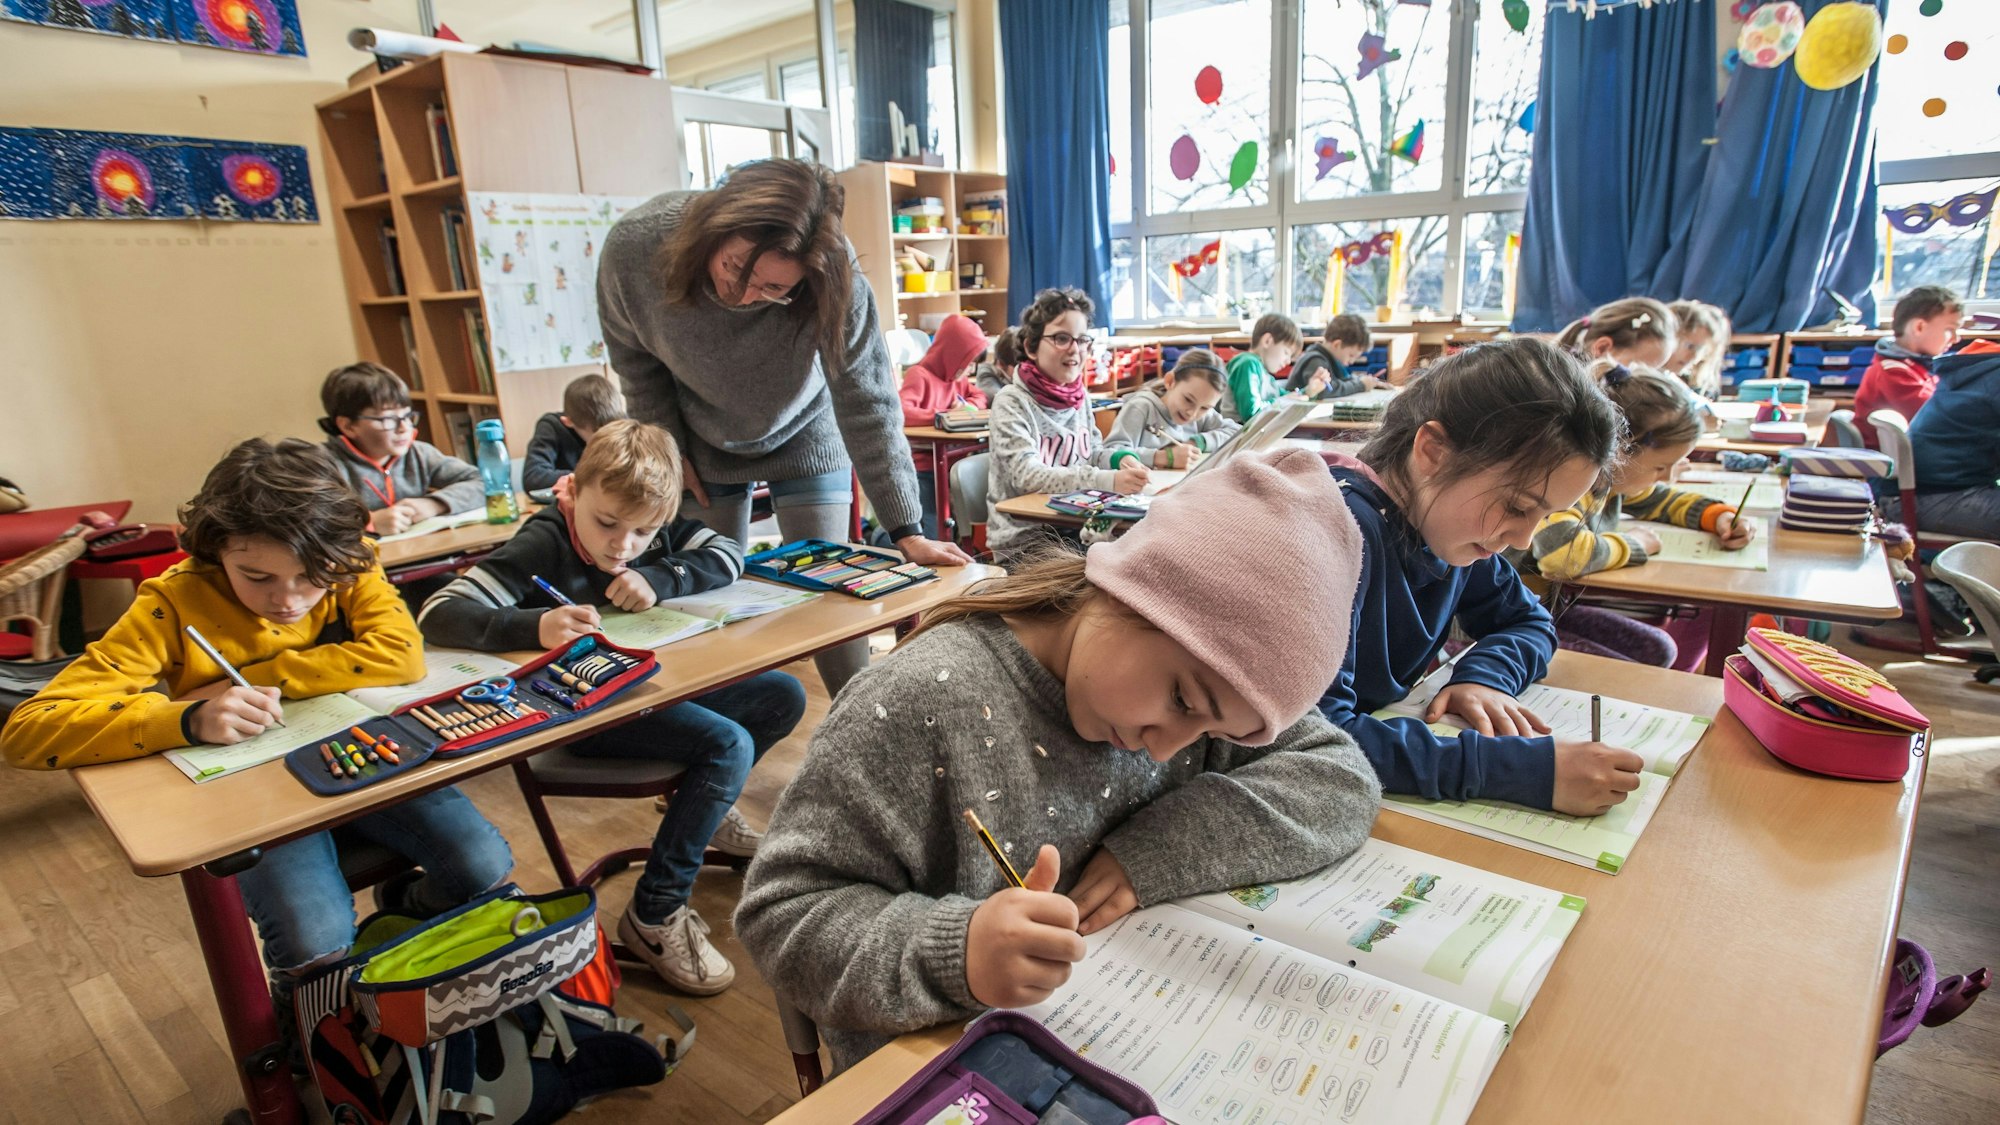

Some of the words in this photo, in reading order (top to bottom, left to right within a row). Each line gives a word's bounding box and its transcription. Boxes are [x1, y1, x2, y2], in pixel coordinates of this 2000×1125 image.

[1148, 923, 1162, 938] stark
[1198, 938, 1218, 962] nützlich
[1210, 953, 1227, 974] Grundstufe
[1124, 968, 1145, 989] braver
[1154, 978, 1171, 998] dicker
[1254, 976, 1268, 994] Adjektive
[1278, 966, 1295, 994] bequemsten
[1304, 977, 1313, 987] jung
[1214, 980, 1228, 998] Markiere
[1319, 979, 1335, 1005] schwersten
[1174, 997, 1197, 1024] Vergleichsstufe
[1243, 994, 1256, 1013] geordnet
[1260, 1005, 1273, 1025] schneller
[1279, 1011, 1294, 1032] schwerer
[1303, 1019, 1314, 1037] schnell
[1326, 1028, 1337, 1043] früher
[1409, 1024, 1417, 1035] einer
[1417, 1020, 1430, 1040] Adjektive
[1348, 1035, 1358, 1050] wilder
[1371, 1038, 1383, 1059] bequem
[1408, 1040, 1420, 1060] gehören
[1131, 1046, 1158, 1072] Vergleichsstufe
[1191, 1062, 1200, 1073] wilder
[1231, 1048, 1247, 1069] kleinsten
[1258, 1057, 1267, 1069] kühl
[1277, 1059, 1293, 1084] bequemer
[1298, 1073, 1312, 1096] wildesten
[1325, 1080, 1336, 1098] schwer
[1205, 1096, 1215, 1104] früh
[1225, 1101, 1238, 1117] kleiner
[1344, 1089, 1359, 1113] jüngsten
